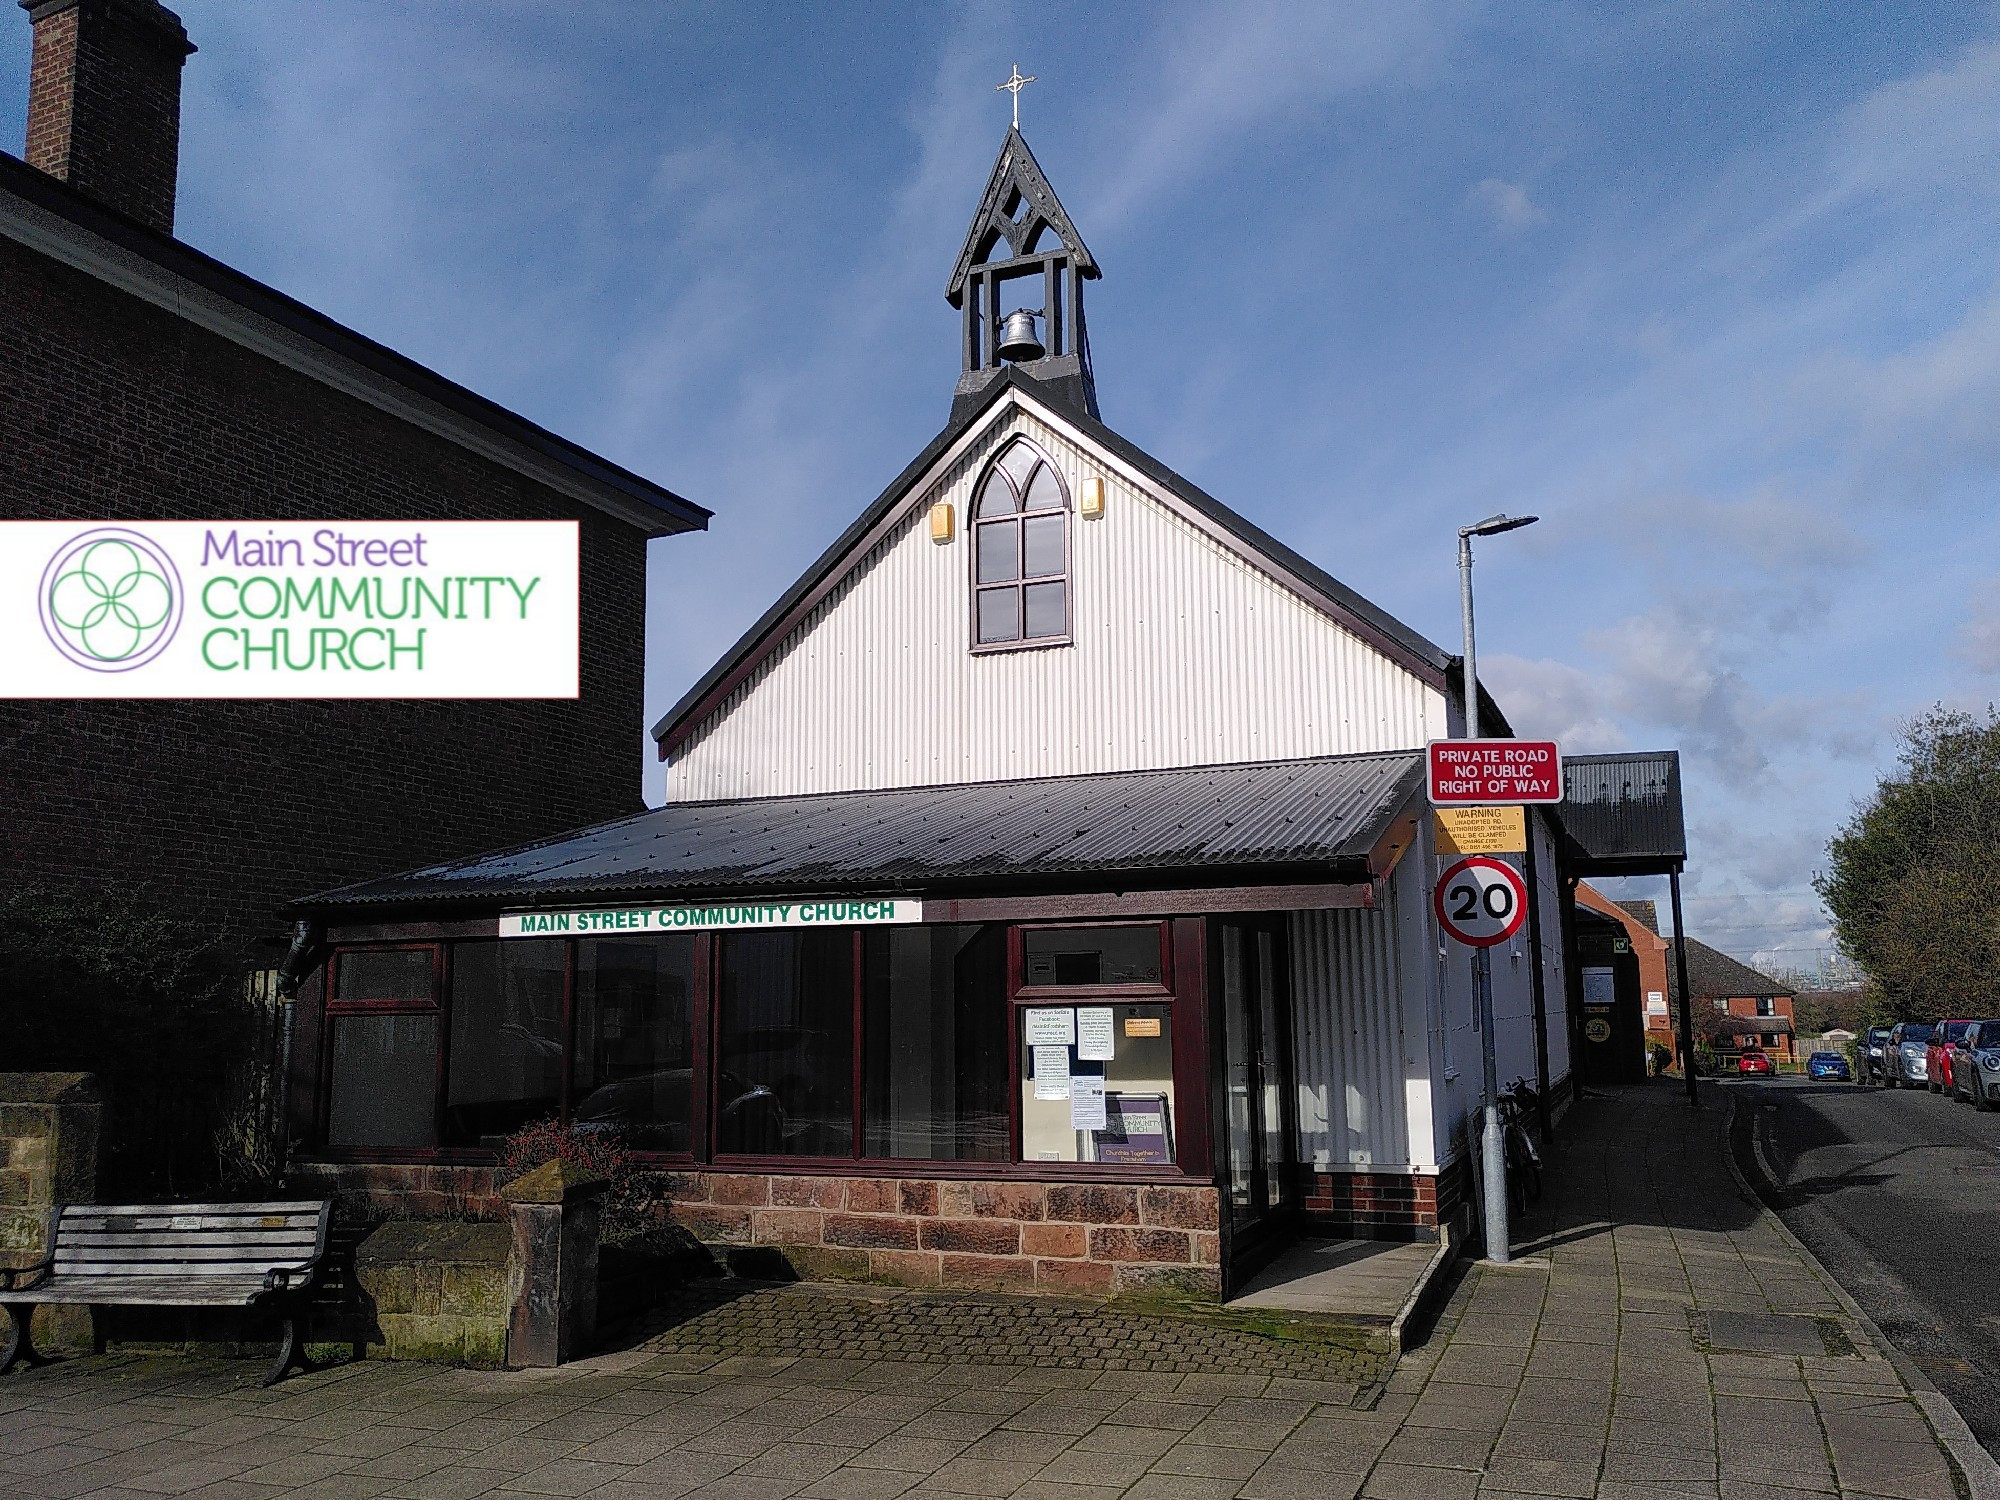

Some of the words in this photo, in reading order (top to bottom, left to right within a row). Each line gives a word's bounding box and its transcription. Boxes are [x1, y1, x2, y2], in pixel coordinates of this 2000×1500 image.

[1439, 750, 1500, 763] PRIVATE
[1505, 749, 1549, 762] ROAD
[1454, 765, 1478, 778] NO
[1483, 764, 1534, 778] PUBLIC
[1439, 780, 1482, 793] RIGHT
[1487, 780, 1509, 793] OF
[1514, 779, 1551, 793] WAY
[1455, 808, 1501, 818] WARNING
[1449, 883, 1513, 920] 20
[520, 914, 570, 933] MAIN
[576, 910, 652, 931] STREET
[657, 904, 792, 928] COMMUNITY
[799, 901, 896, 923] CHURCH
[1130, 1149, 1154, 1157] Together
